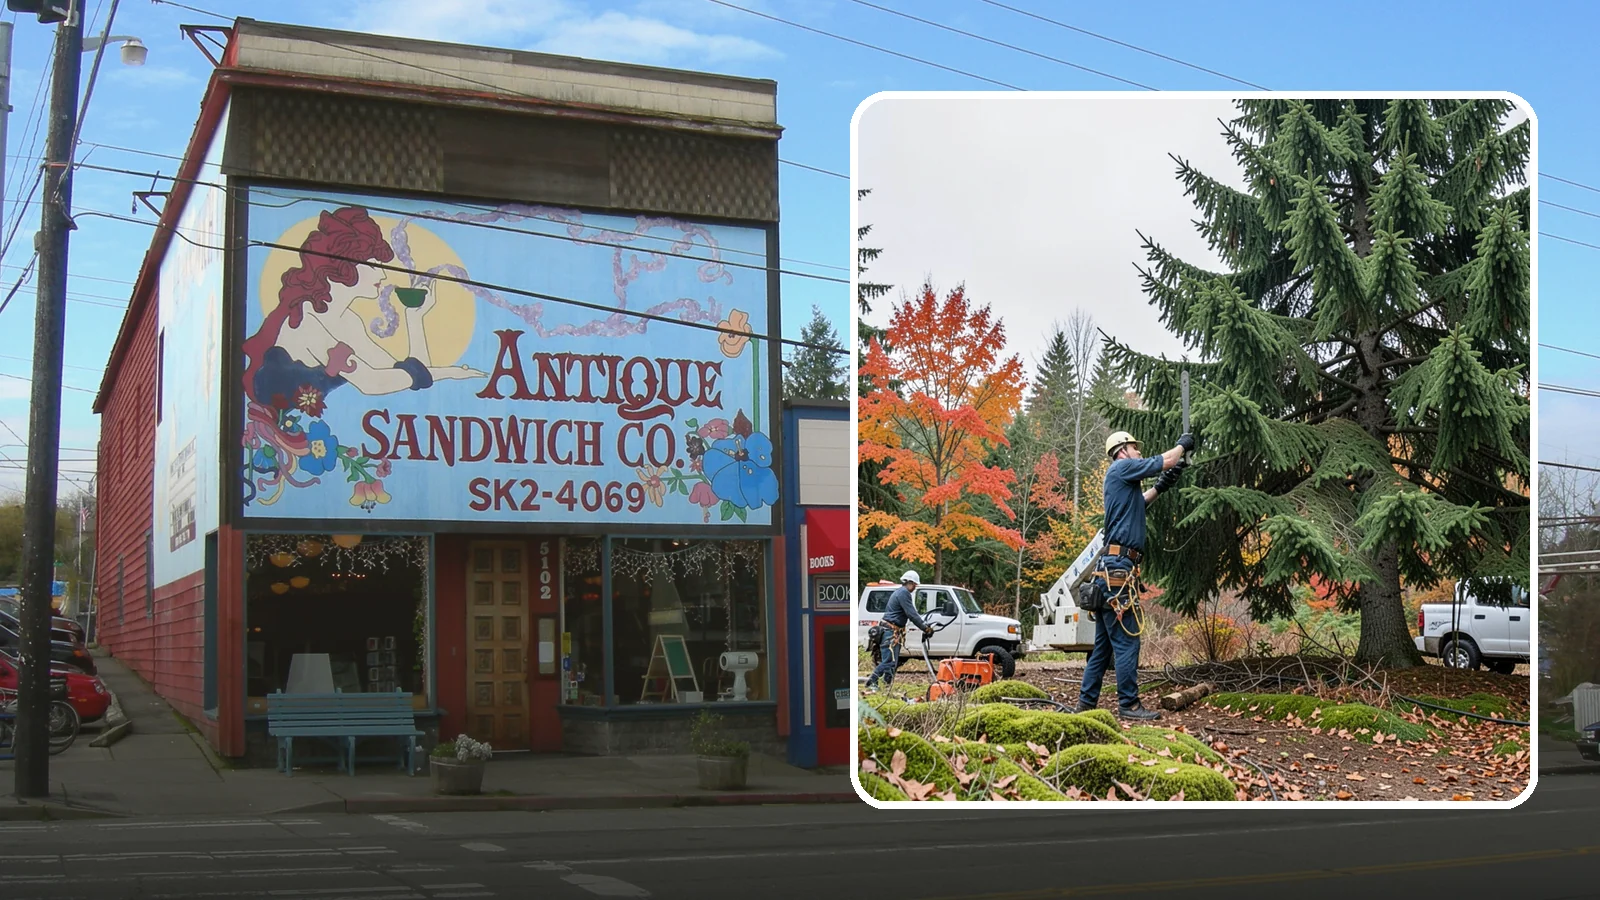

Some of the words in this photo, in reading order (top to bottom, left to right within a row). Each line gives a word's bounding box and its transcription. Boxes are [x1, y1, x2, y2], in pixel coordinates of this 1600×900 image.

[476, 329, 724, 421] ANTIQUE
[361, 408, 605, 467] SANDWICH
[616, 422, 685, 468] CO.
[468, 477, 645, 513] SK2-4069
[540, 542, 552, 600] 5102
[809, 555, 835, 569] BOOKS
